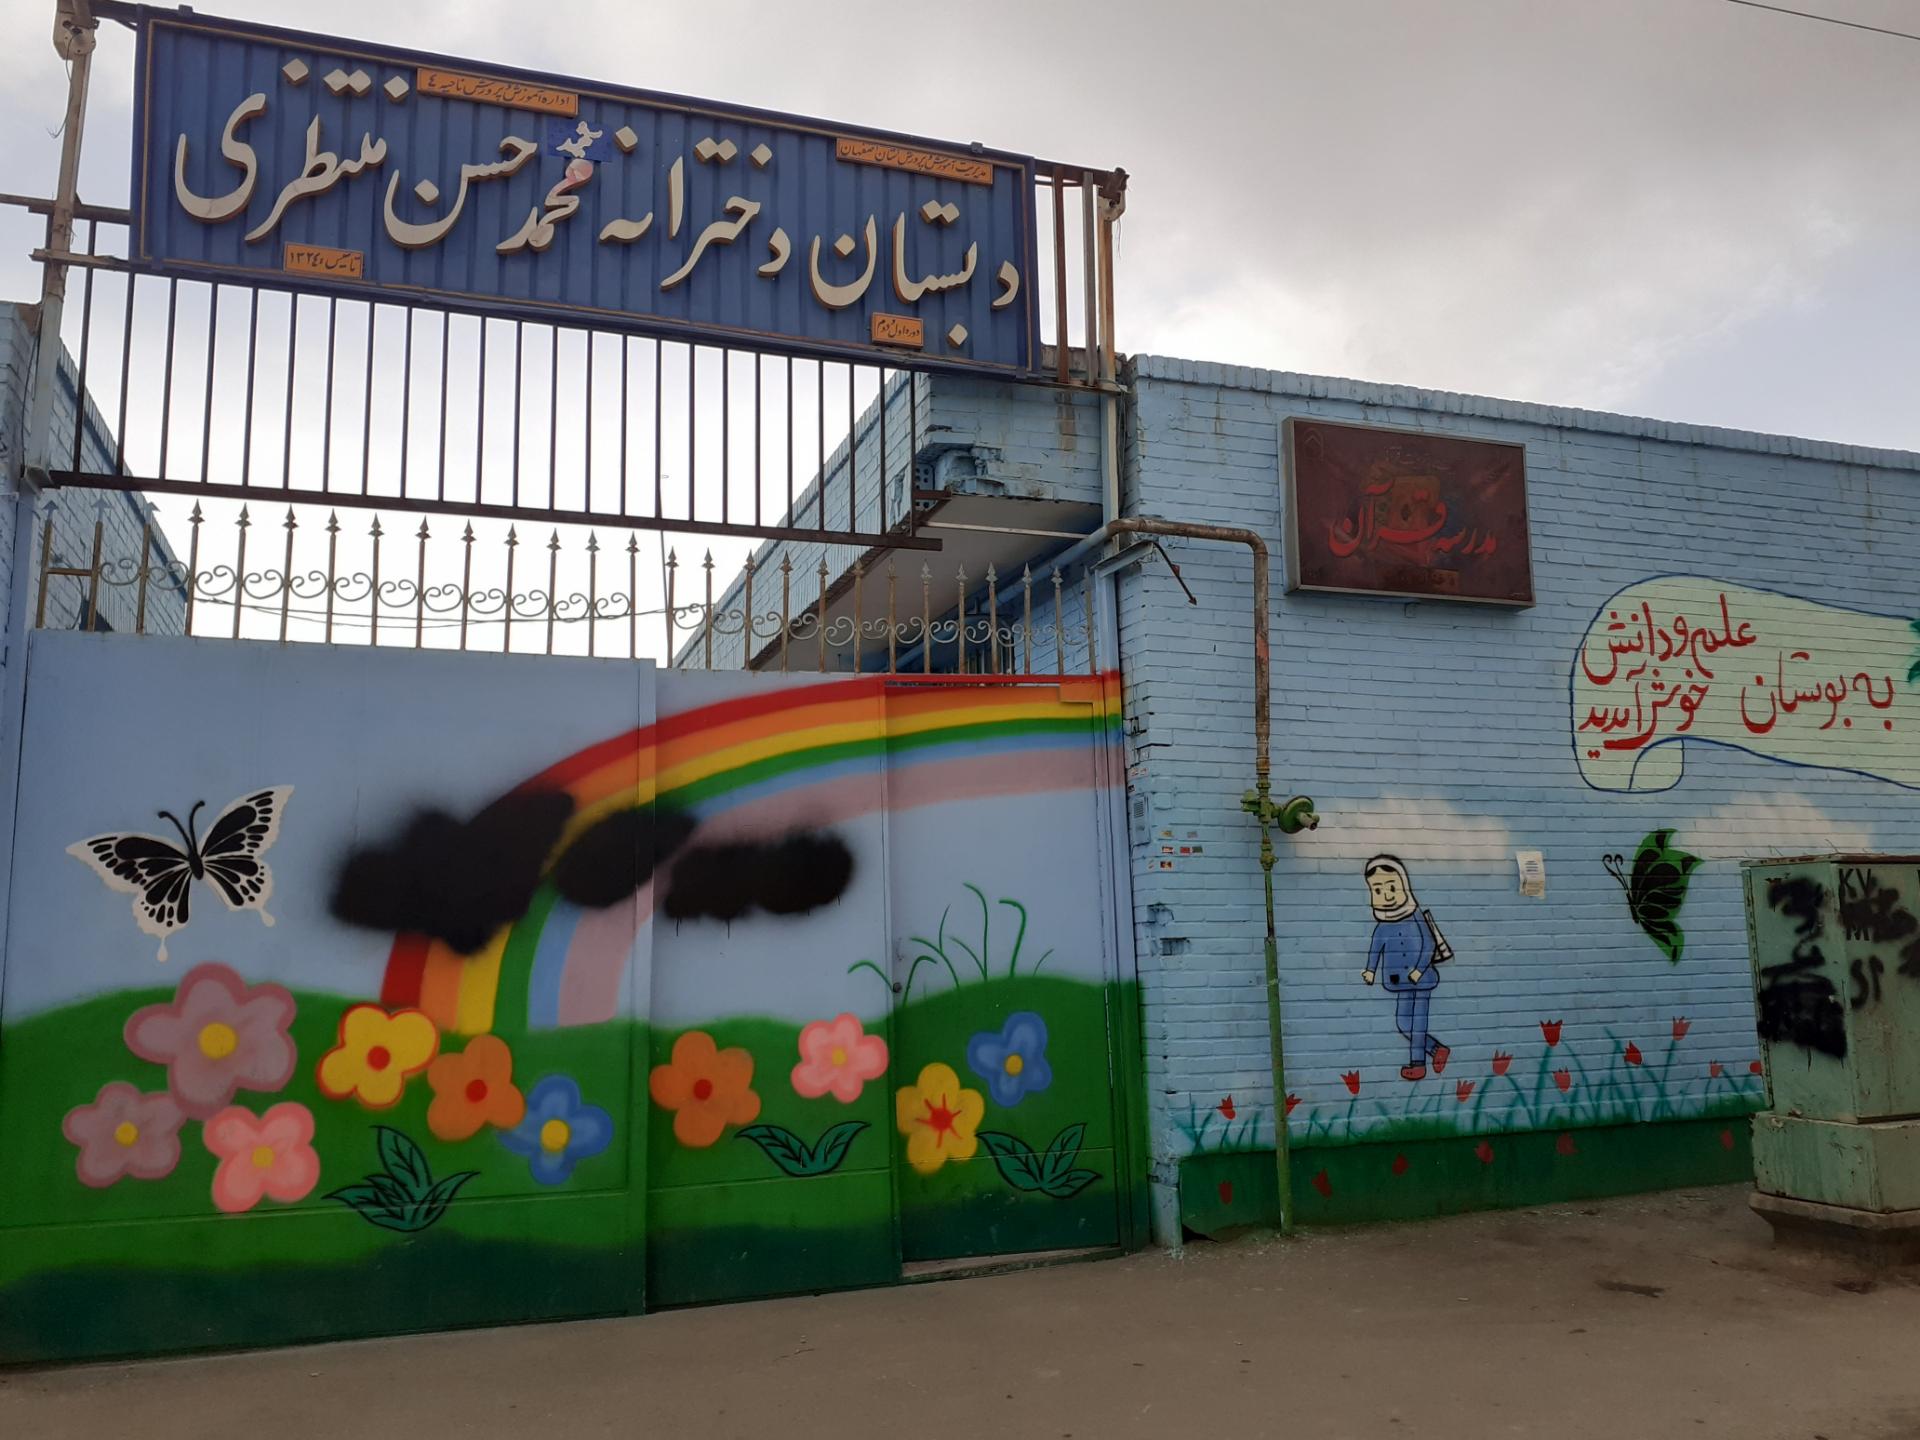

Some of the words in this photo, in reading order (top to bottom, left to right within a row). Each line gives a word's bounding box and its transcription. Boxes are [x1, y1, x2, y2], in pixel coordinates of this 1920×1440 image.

[440, 78, 464, 92] ناحیه
[463, 79, 502, 99] پرورش
[503, 84, 543, 102] آموزش
[542, 95, 570, 106] اداره
[174, 58, 410, 243] منتظری
[840, 142, 879, 157] اصفهان
[897, 151, 925, 171] پرورش
[925, 156, 956, 172] آموزش
[956, 161, 987, 179] مدیریت
[384, 135, 539, 250] حسن
[495, 158, 594, 255] محمد
[600, 126, 792, 290] دخترانه
[809, 199, 1020, 348] دبستان
[1328, 479, 1446, 558] قرآن
[1430, 526, 1497, 556] مدرسه
[1581, 601, 1674, 685] دانش
[1673, 615, 1690, 658] و
[1690, 593, 1757, 679] علم
[1578, 660, 1648, 759] آمدید
[1603, 668, 1710, 751] خوش
[1741, 651, 1852, 734] بوستان
[1853, 672, 1894, 731] به
